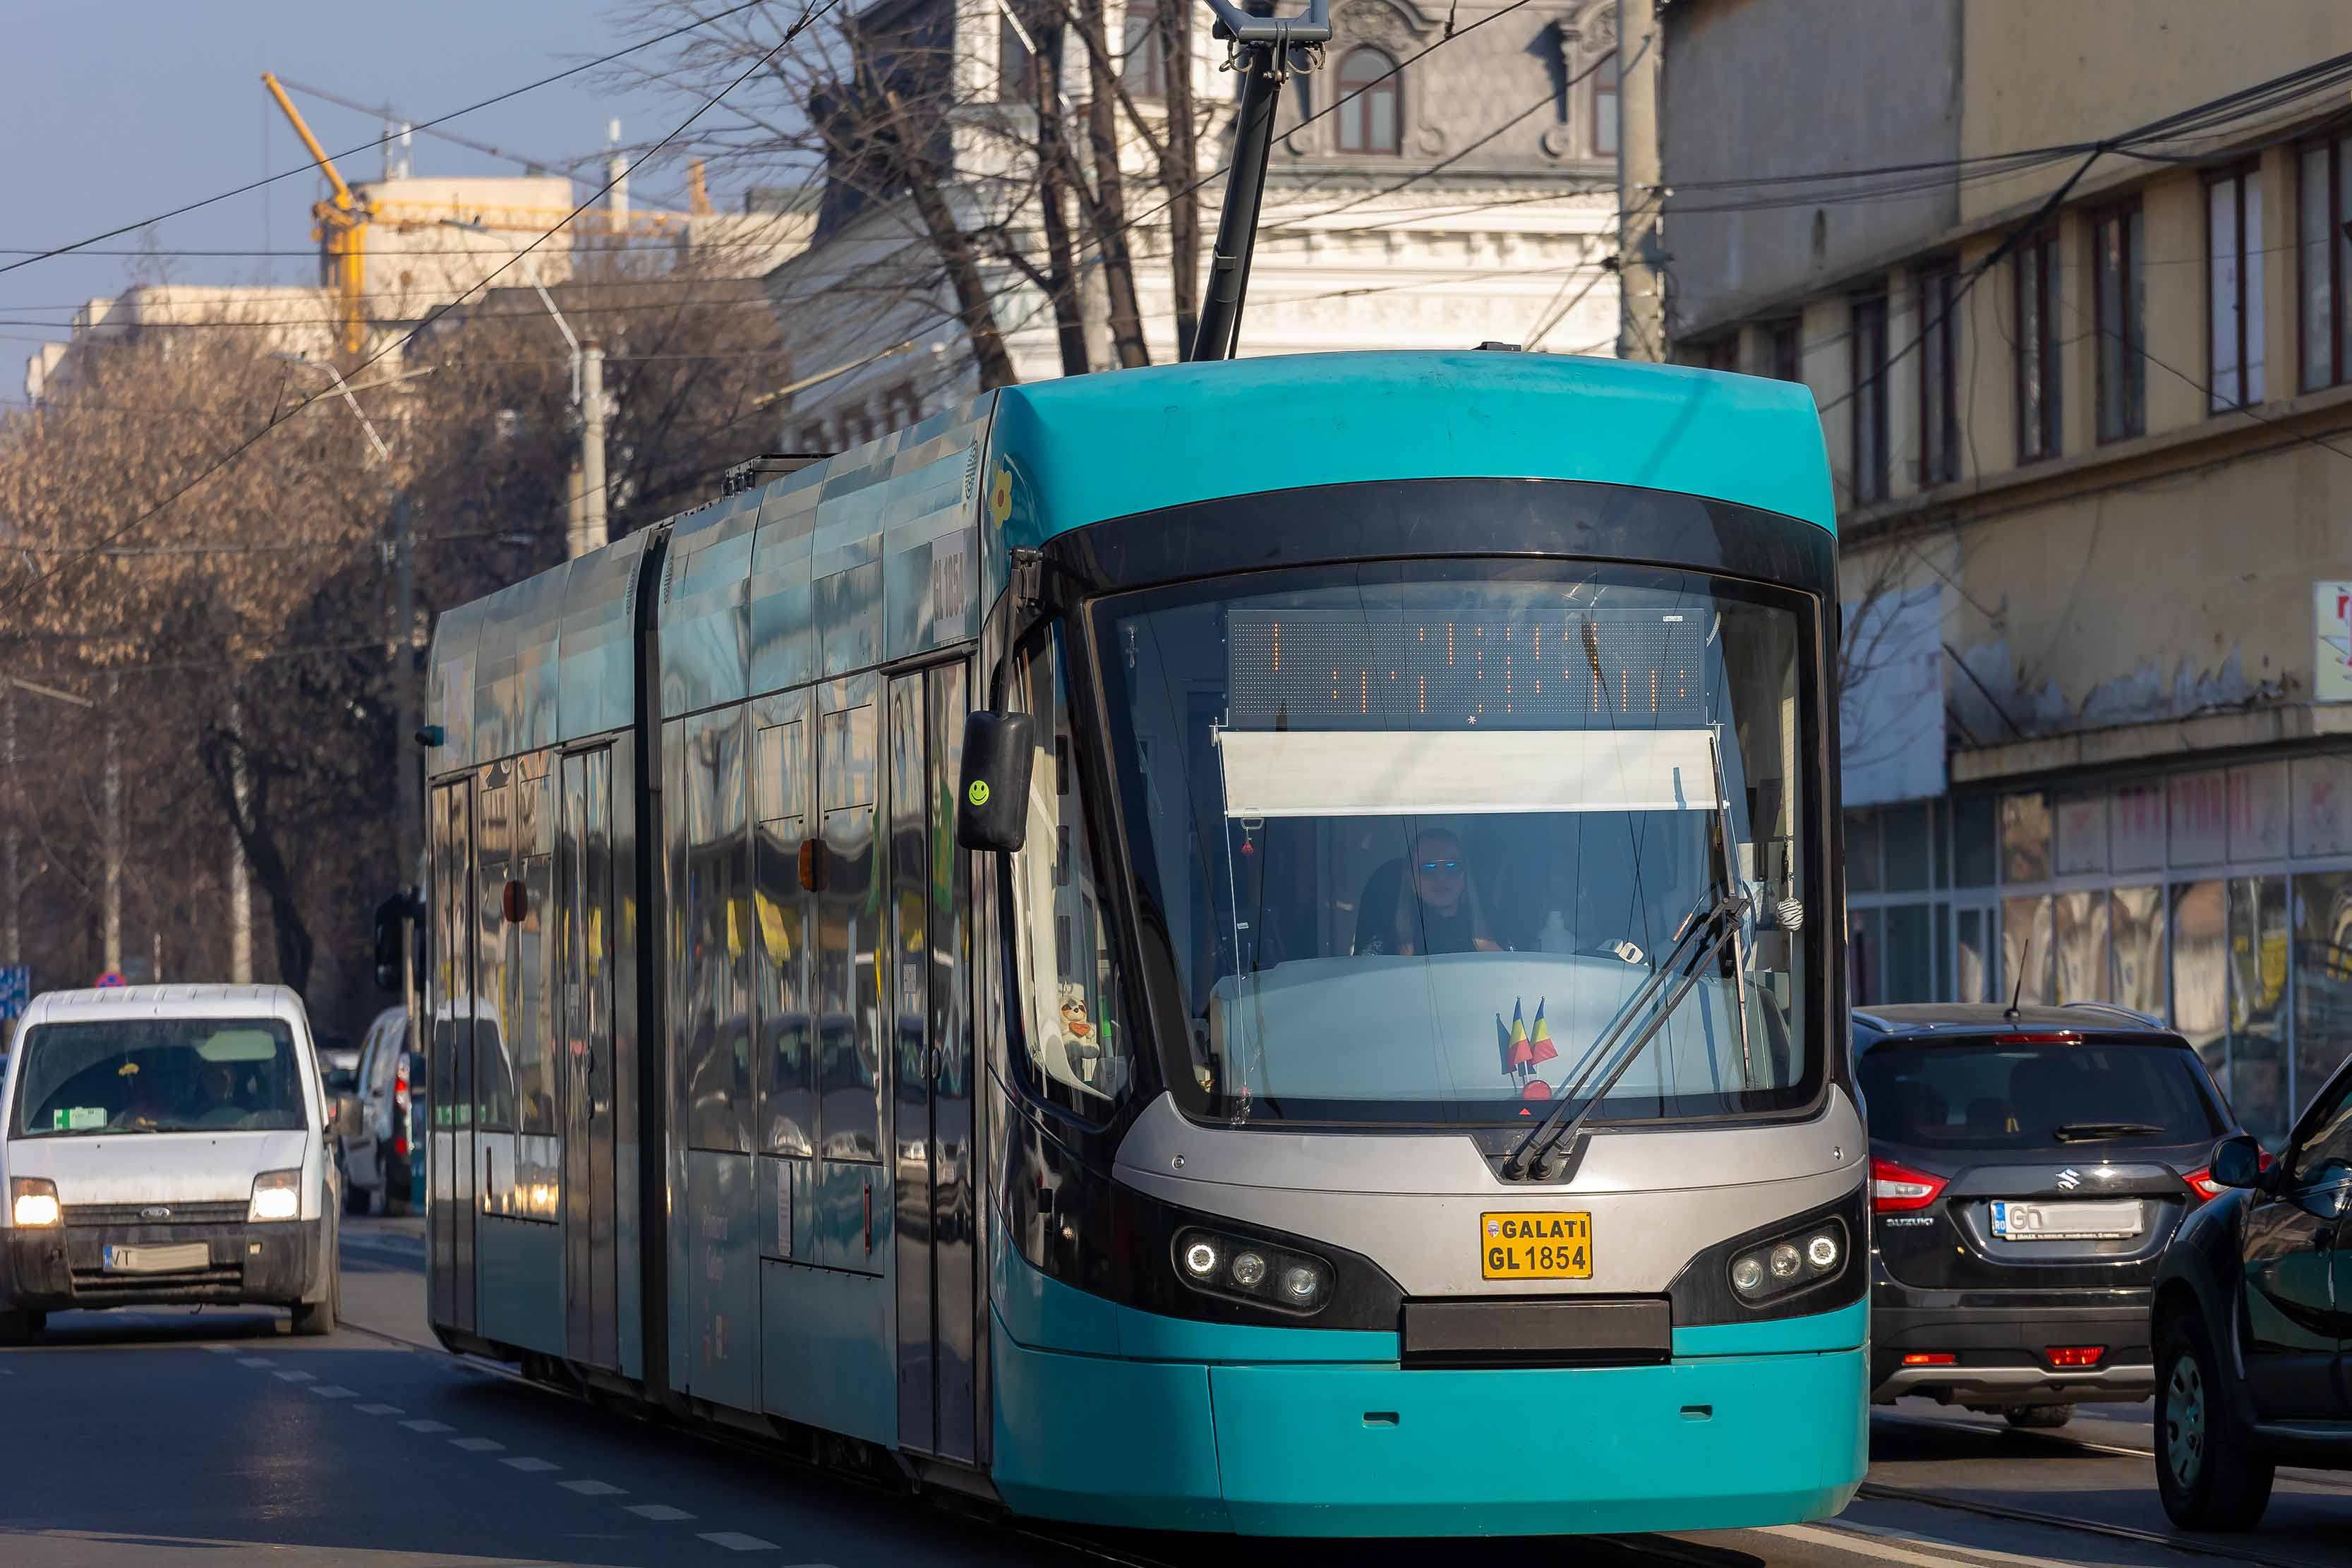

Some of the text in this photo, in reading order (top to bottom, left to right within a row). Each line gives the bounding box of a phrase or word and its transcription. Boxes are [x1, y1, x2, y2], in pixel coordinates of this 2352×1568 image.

[1502, 1220, 1586, 1238] GALATI
[1995, 1220, 2006, 1230] RO
[1488, 1246, 1586, 1270] GL 1854
